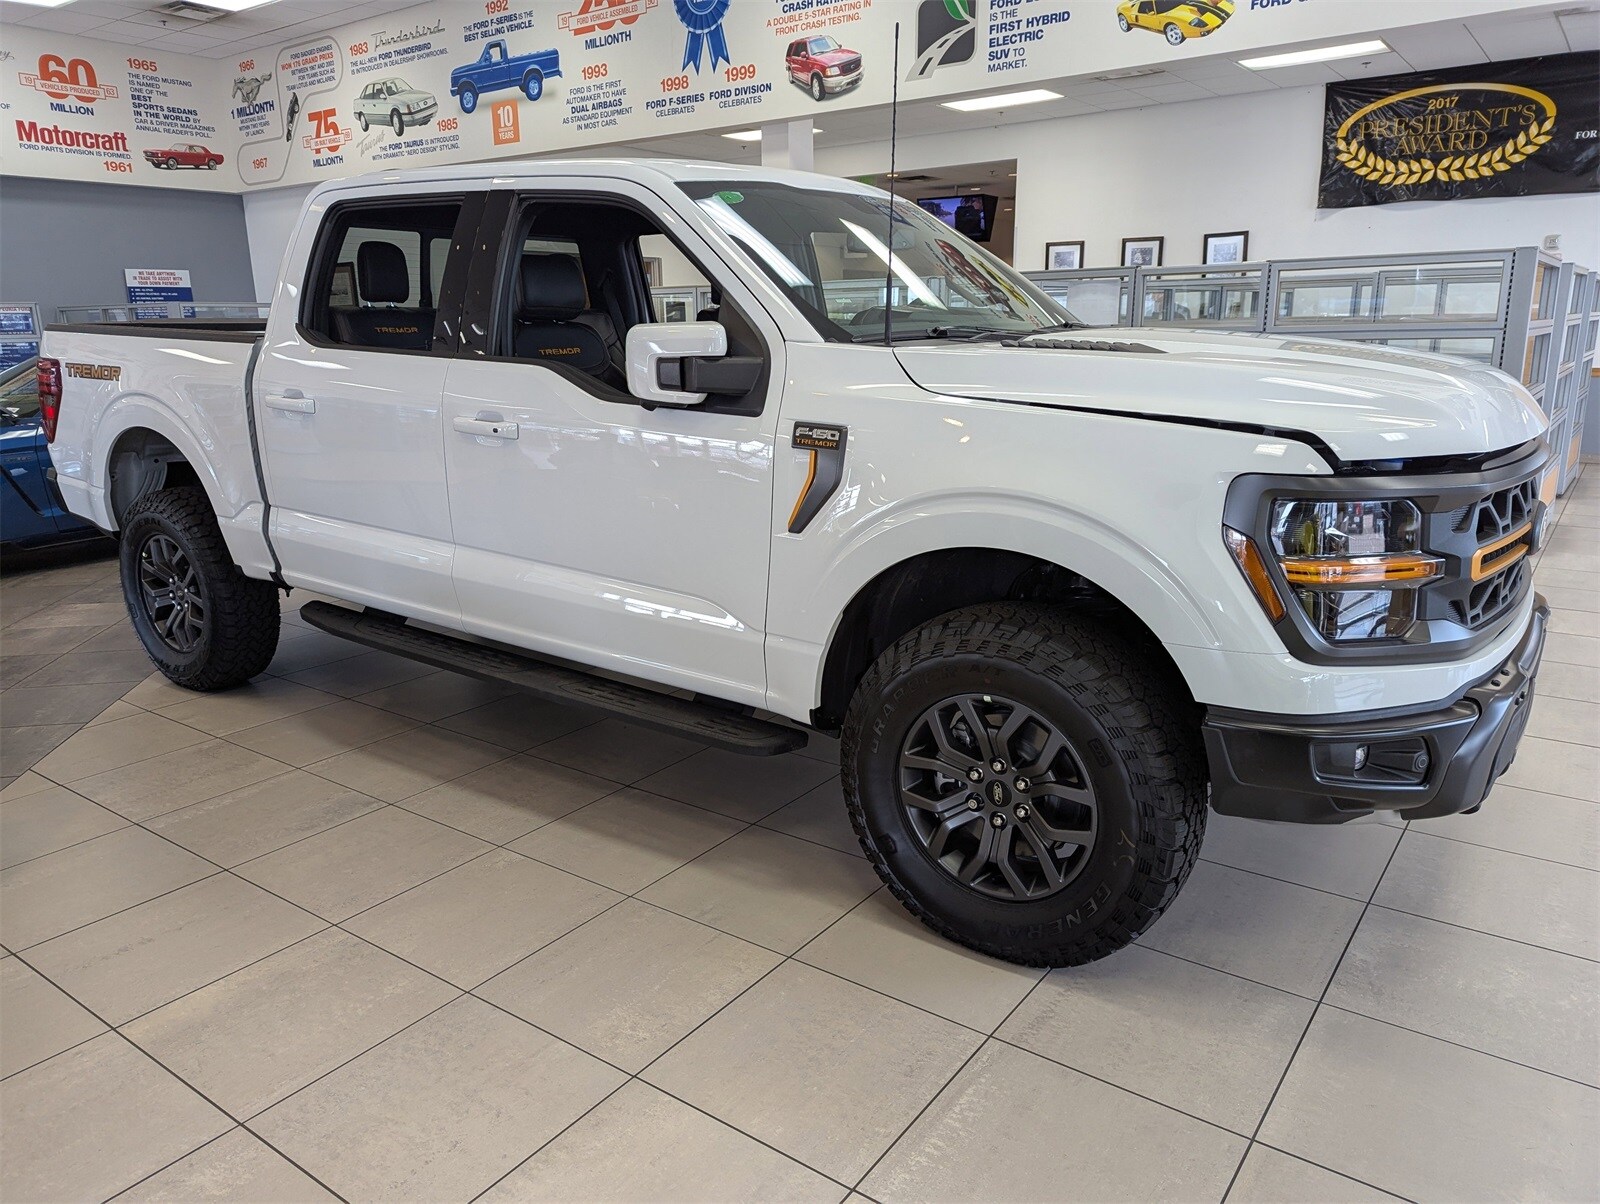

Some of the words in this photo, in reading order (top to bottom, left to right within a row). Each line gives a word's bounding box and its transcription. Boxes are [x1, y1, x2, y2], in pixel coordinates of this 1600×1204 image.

[485, 0, 508, 15] 1992
[782, 0, 813, 13] CRASH
[473, 21, 490, 30] FORD
[490, 13, 518, 26] F-SERIES
[518, 12, 523, 20] IS
[524, 10, 534, 18] THE
[561, 17, 568, 25] 19
[576, 16, 589, 25] FORD
[590, 11, 609, 23] VEHICLE
[610, 4, 638, 18] ASSEMBLED
[766, 20, 772, 28] A
[774, 13, 803, 26] DOUBLE
[804, 8, 831, 20] 5-STAR
[833, 2, 862, 14] RATING
[864, 0, 872, 8] IN
[990, 12, 998, 22] IS
[1000, 8, 1018, 20] THE
[776, 24, 800, 36] FRONT
[801, 19, 826, 31] CRASH
[828, 12, 862, 26] TESTING.
[990, 20, 1022, 34] FIRST
[1026, 11, 1070, 28] HYBRID
[349, 42, 368, 56] 1983
[370, 18, 446, 52] Thunderbird
[464, 32, 480, 42] BEST
[481, 28, 505, 39] SELLING
[506, 20, 534, 32] VEHICLE.
[585, 30, 632, 50] MILLIONTH
[989, 29, 1044, 48] ELECTRIC
[316, 44, 332, 54] ENGINES
[359, 56, 378, 66] ALL-NEW
[378, 52, 392, 60] FORD
[394, 42, 432, 57] THUNDERBIRD
[988, 48, 1010, 61] SUV
[1013, 47, 1025, 57] TO
[127, 58, 158, 72] 1965
[239, 60, 254, 72] 1966
[281, 62, 292, 70] WON
[302, 56, 318, 66] GRAND
[356, 62, 383, 74] INTRODUCED
[389, 55, 416, 66] DEALERSHIP
[416, 48, 448, 60] SHOWROOMS.
[988, 58, 1028, 73] MARKET.
[38, 54, 97, 103] 60
[291, 67, 308, 76] BETWEEN
[306, 71, 318, 79] TEAMS
[582, 64, 608, 80] 1993
[725, 64, 756, 82] 1999
[24, 76, 32, 84] 19
[136, 80, 160, 89] NAMED
[142, 74, 160, 82] FORD
[161, 78, 192, 87] MUSTANG
[296, 82, 308, 90] LOTUS
[660, 75, 689, 92] 1998
[40, 82, 68, 92] VEHICLES
[70, 87, 100, 96] PRODUCED
[570, 85, 586, 96] FORD
[586, 84, 592, 92] IS
[592, 82, 604, 91] THE
[605, 80, 622, 88] FIRST
[710, 88, 732, 100] FORD
[734, 82, 772, 96] DIVISION
[131, 94, 152, 102] BEST
[566, 93, 601, 105] AUTOMAKER
[612, 88, 627, 98] HAVE
[646, 99, 666, 110] FORD
[669, 93, 704, 106] F-SERIES
[718, 96, 762, 108] CELEBRATES
[1428, 96, 1459, 110] 2017
[50, 102, 94, 116] MILLION
[132, 102, 164, 112] SPORTS
[166, 106, 198, 116] SEDANS
[231, 110, 235, 119] 1
[236, 100, 274, 118] MILLIONTH
[571, 104, 590, 114] DUAL
[592, 98, 622, 111] AIRBAGS
[656, 105, 695, 118] CELEBRATES
[144, 111, 160, 119] THE
[162, 114, 190, 122] WORLD
[240, 116, 256, 124] MUSTANG
[498, 105, 514, 128] 10
[570, 112, 599, 124] STANDARD
[600, 107, 632, 119] EQUIPMENT
[1358, 104, 1537, 141] PRESIDENT'S
[136, 124, 161, 132] ANNUAL
[163, 128, 194, 136] READER'S
[195, 130, 212, 138] POLL.
[156, 120, 179, 128] DRIVER
[180, 123, 216, 132] MAGAZINES
[239, 124, 250, 132] WITHIN
[259, 120, 270, 128] YEARS
[308, 108, 340, 154] 75
[436, 118, 458, 132] 1985
[584, 122, 600, 130] MOST
[601, 119, 618, 128] CARS.
[16, 120, 128, 152] Motorcraft
[388, 142, 402, 150] FORD
[403, 138, 424, 148] TAURUS
[430, 134, 460, 145] INTRODUCED
[499, 130, 514, 140] YEARS
[1574, 130, 1598, 140] FOR
[1392, 130, 1488, 157] AWARD
[65, 148, 94, 156] DIVISION
[104, 152, 132, 160] FORMED.
[383, 150, 405, 160] DRAMATIC
[440, 142, 460, 151] STYLING.
[104, 160, 132, 173] 1961
[252, 158, 268, 169] 1967
[312, 155, 344, 168] MILLIONTH
[374, 326, 418, 334] TREMOR
[538, 348, 581, 356] TREMOR
[66, 362, 121, 381] TREMOR
[796, 427, 840, 440] F-150
[796, 438, 836, 447] TREMOR
